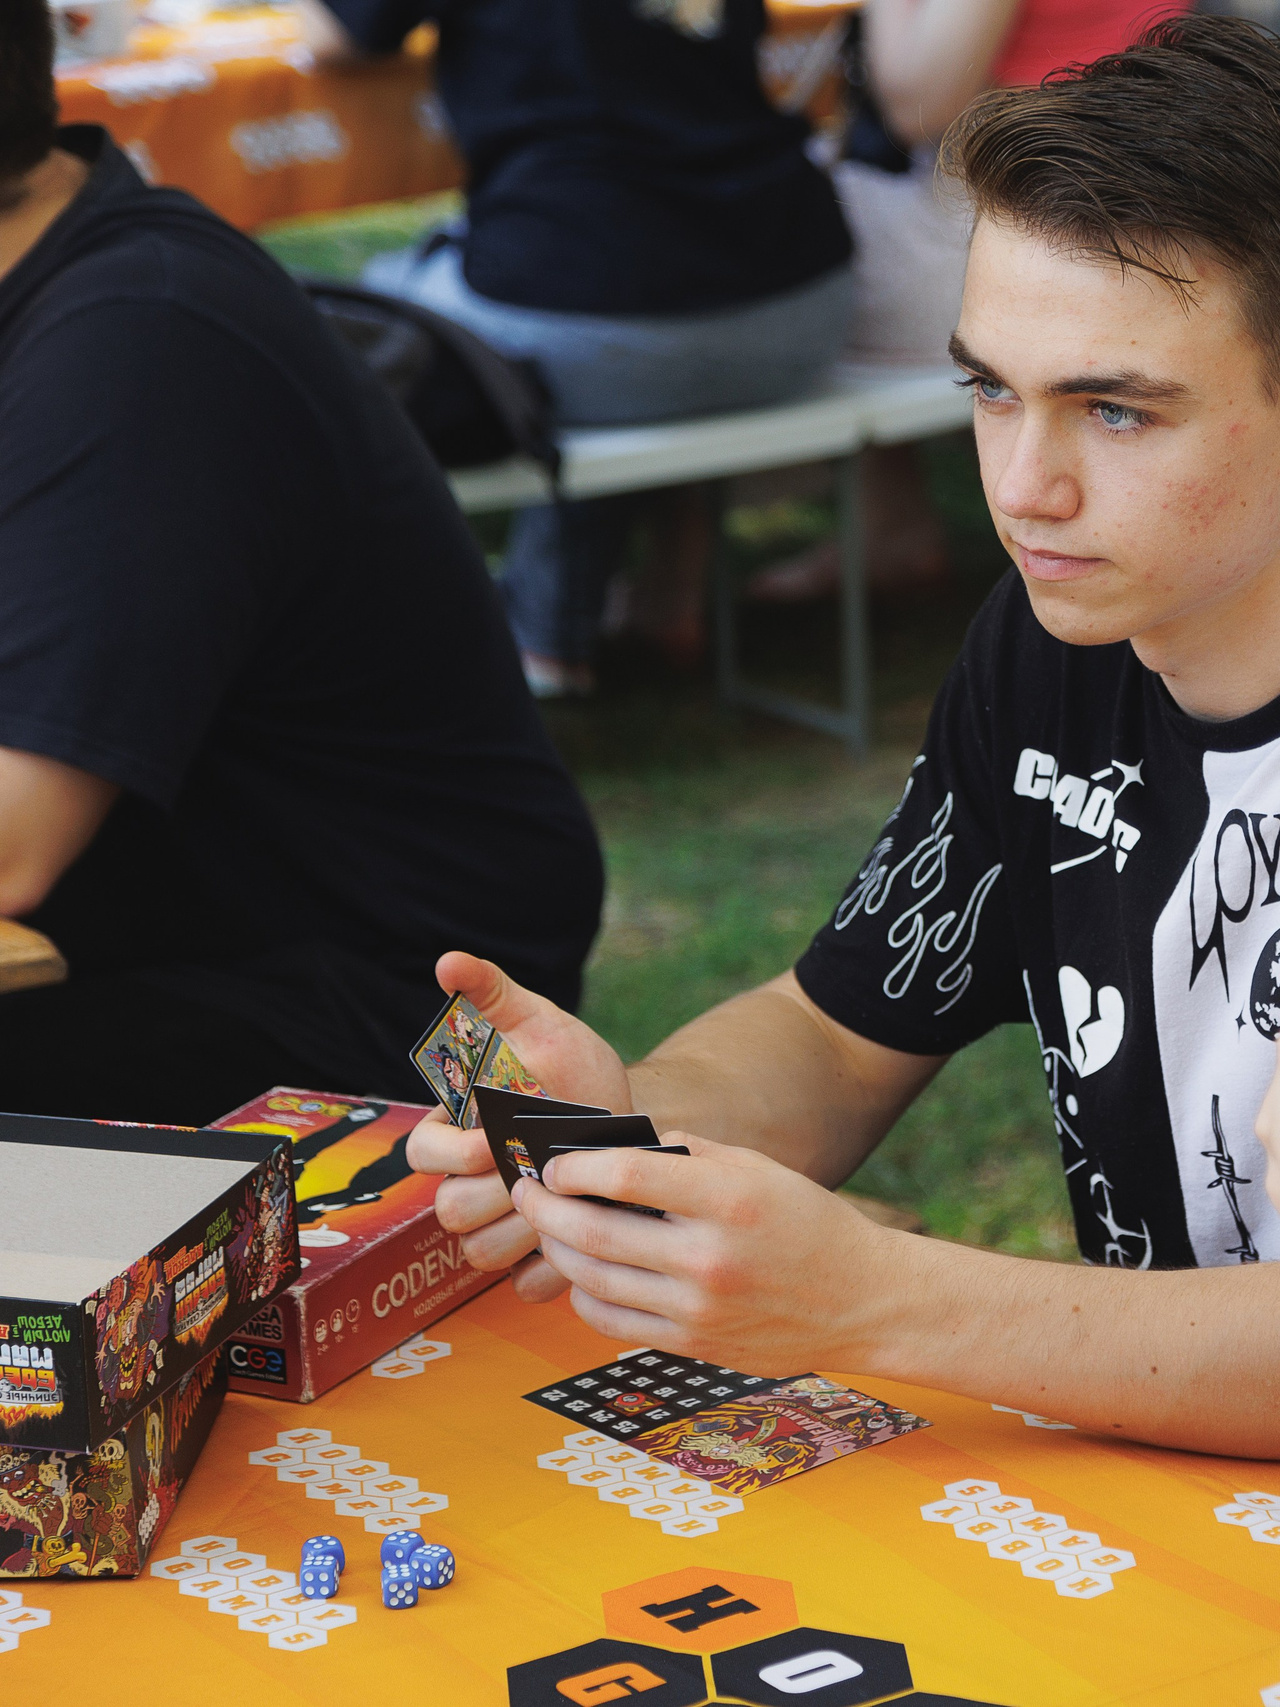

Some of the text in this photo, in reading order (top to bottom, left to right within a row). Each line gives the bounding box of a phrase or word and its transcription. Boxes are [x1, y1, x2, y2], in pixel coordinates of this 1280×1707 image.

[372, 1235, 465, 1318] CODENA
[17, 1314, 63, 1329] ДЕБОШ
[23, 1325, 71, 1344] ЛЮТЫЙ
[6, 1391, 59, 1402] ЭПИЧНЫЕ
